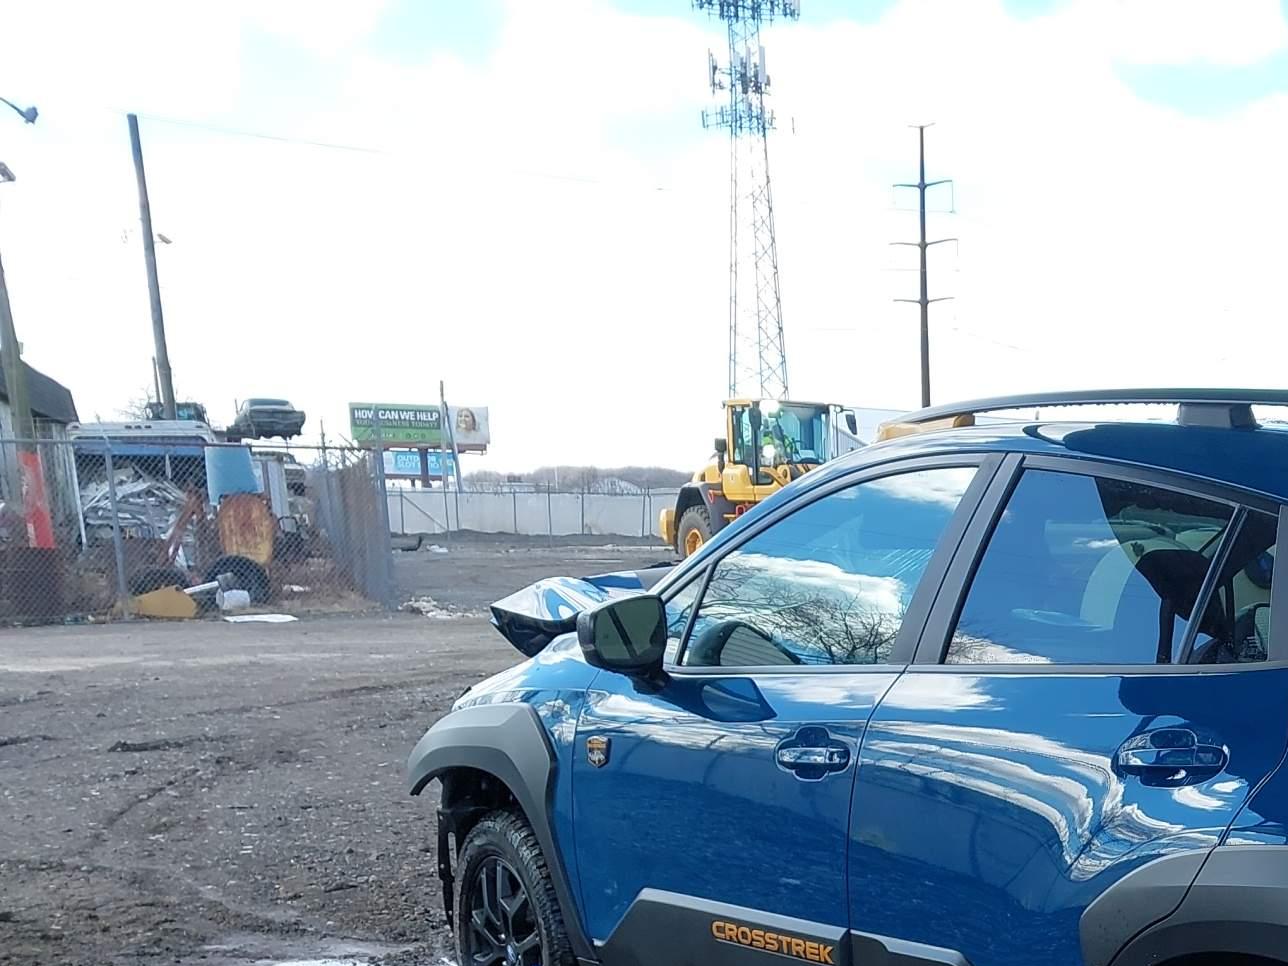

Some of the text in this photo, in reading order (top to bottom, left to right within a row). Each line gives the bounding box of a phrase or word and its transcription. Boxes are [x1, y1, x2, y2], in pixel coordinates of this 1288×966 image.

[378, 409, 400, 421] CAN
[400, 410, 416, 421] WE
[416, 411, 440, 421] HELP
[711, 919, 836, 965] CROSSTREK
